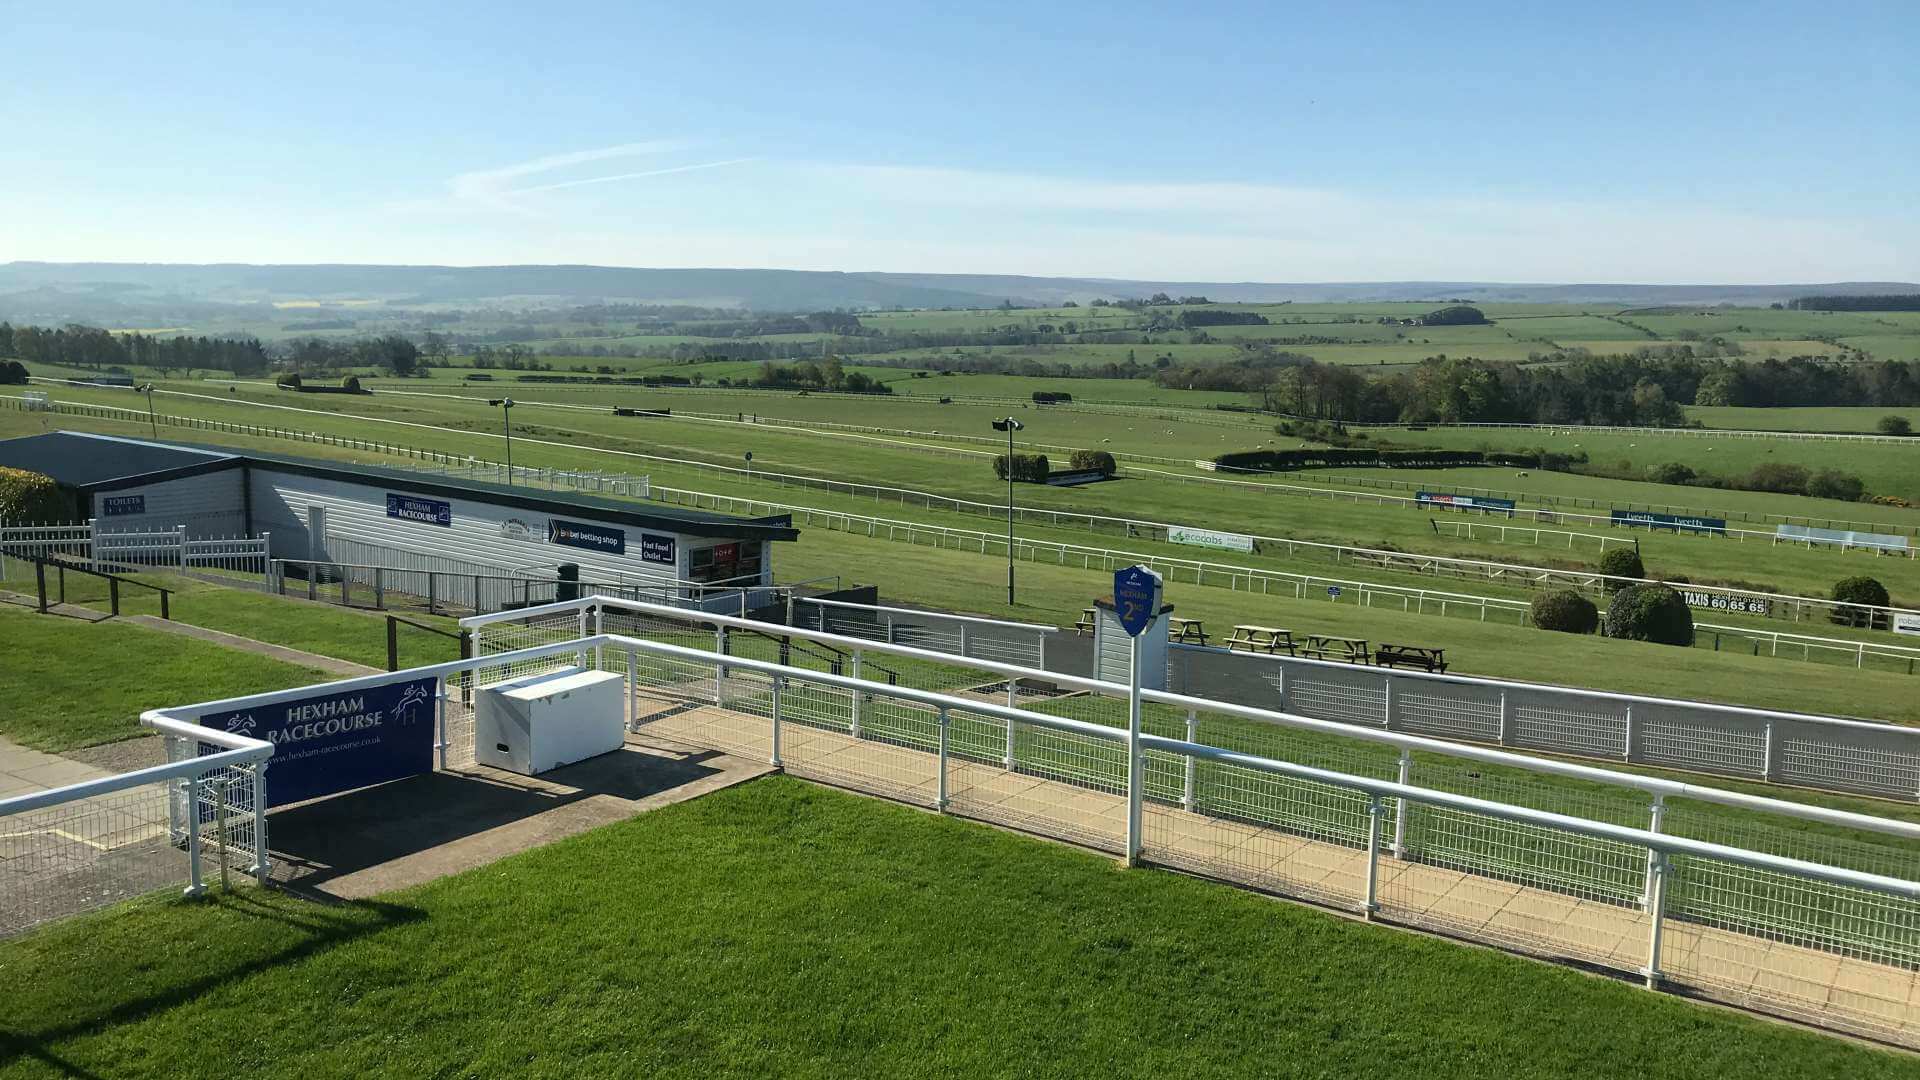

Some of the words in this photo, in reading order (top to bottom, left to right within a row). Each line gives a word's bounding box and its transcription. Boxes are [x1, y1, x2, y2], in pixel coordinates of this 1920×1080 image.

[398, 509, 438, 522] RACECOURSE
[580, 531, 602, 544] betting
[602, 536, 618, 547] shop
[643, 541, 654, 550] Fast
[655, 543, 669, 551] Food
[643, 551, 661, 561] Outlet
[1684, 591, 1709, 607] TAXIS
[1711, 599, 1727, 609] 60
[1730, 601, 1746, 611] 65
[1749, 603, 1765, 613] 65
[287, 696, 365, 723] HEXHAM
[267, 711, 384, 744] RACECOURSE
